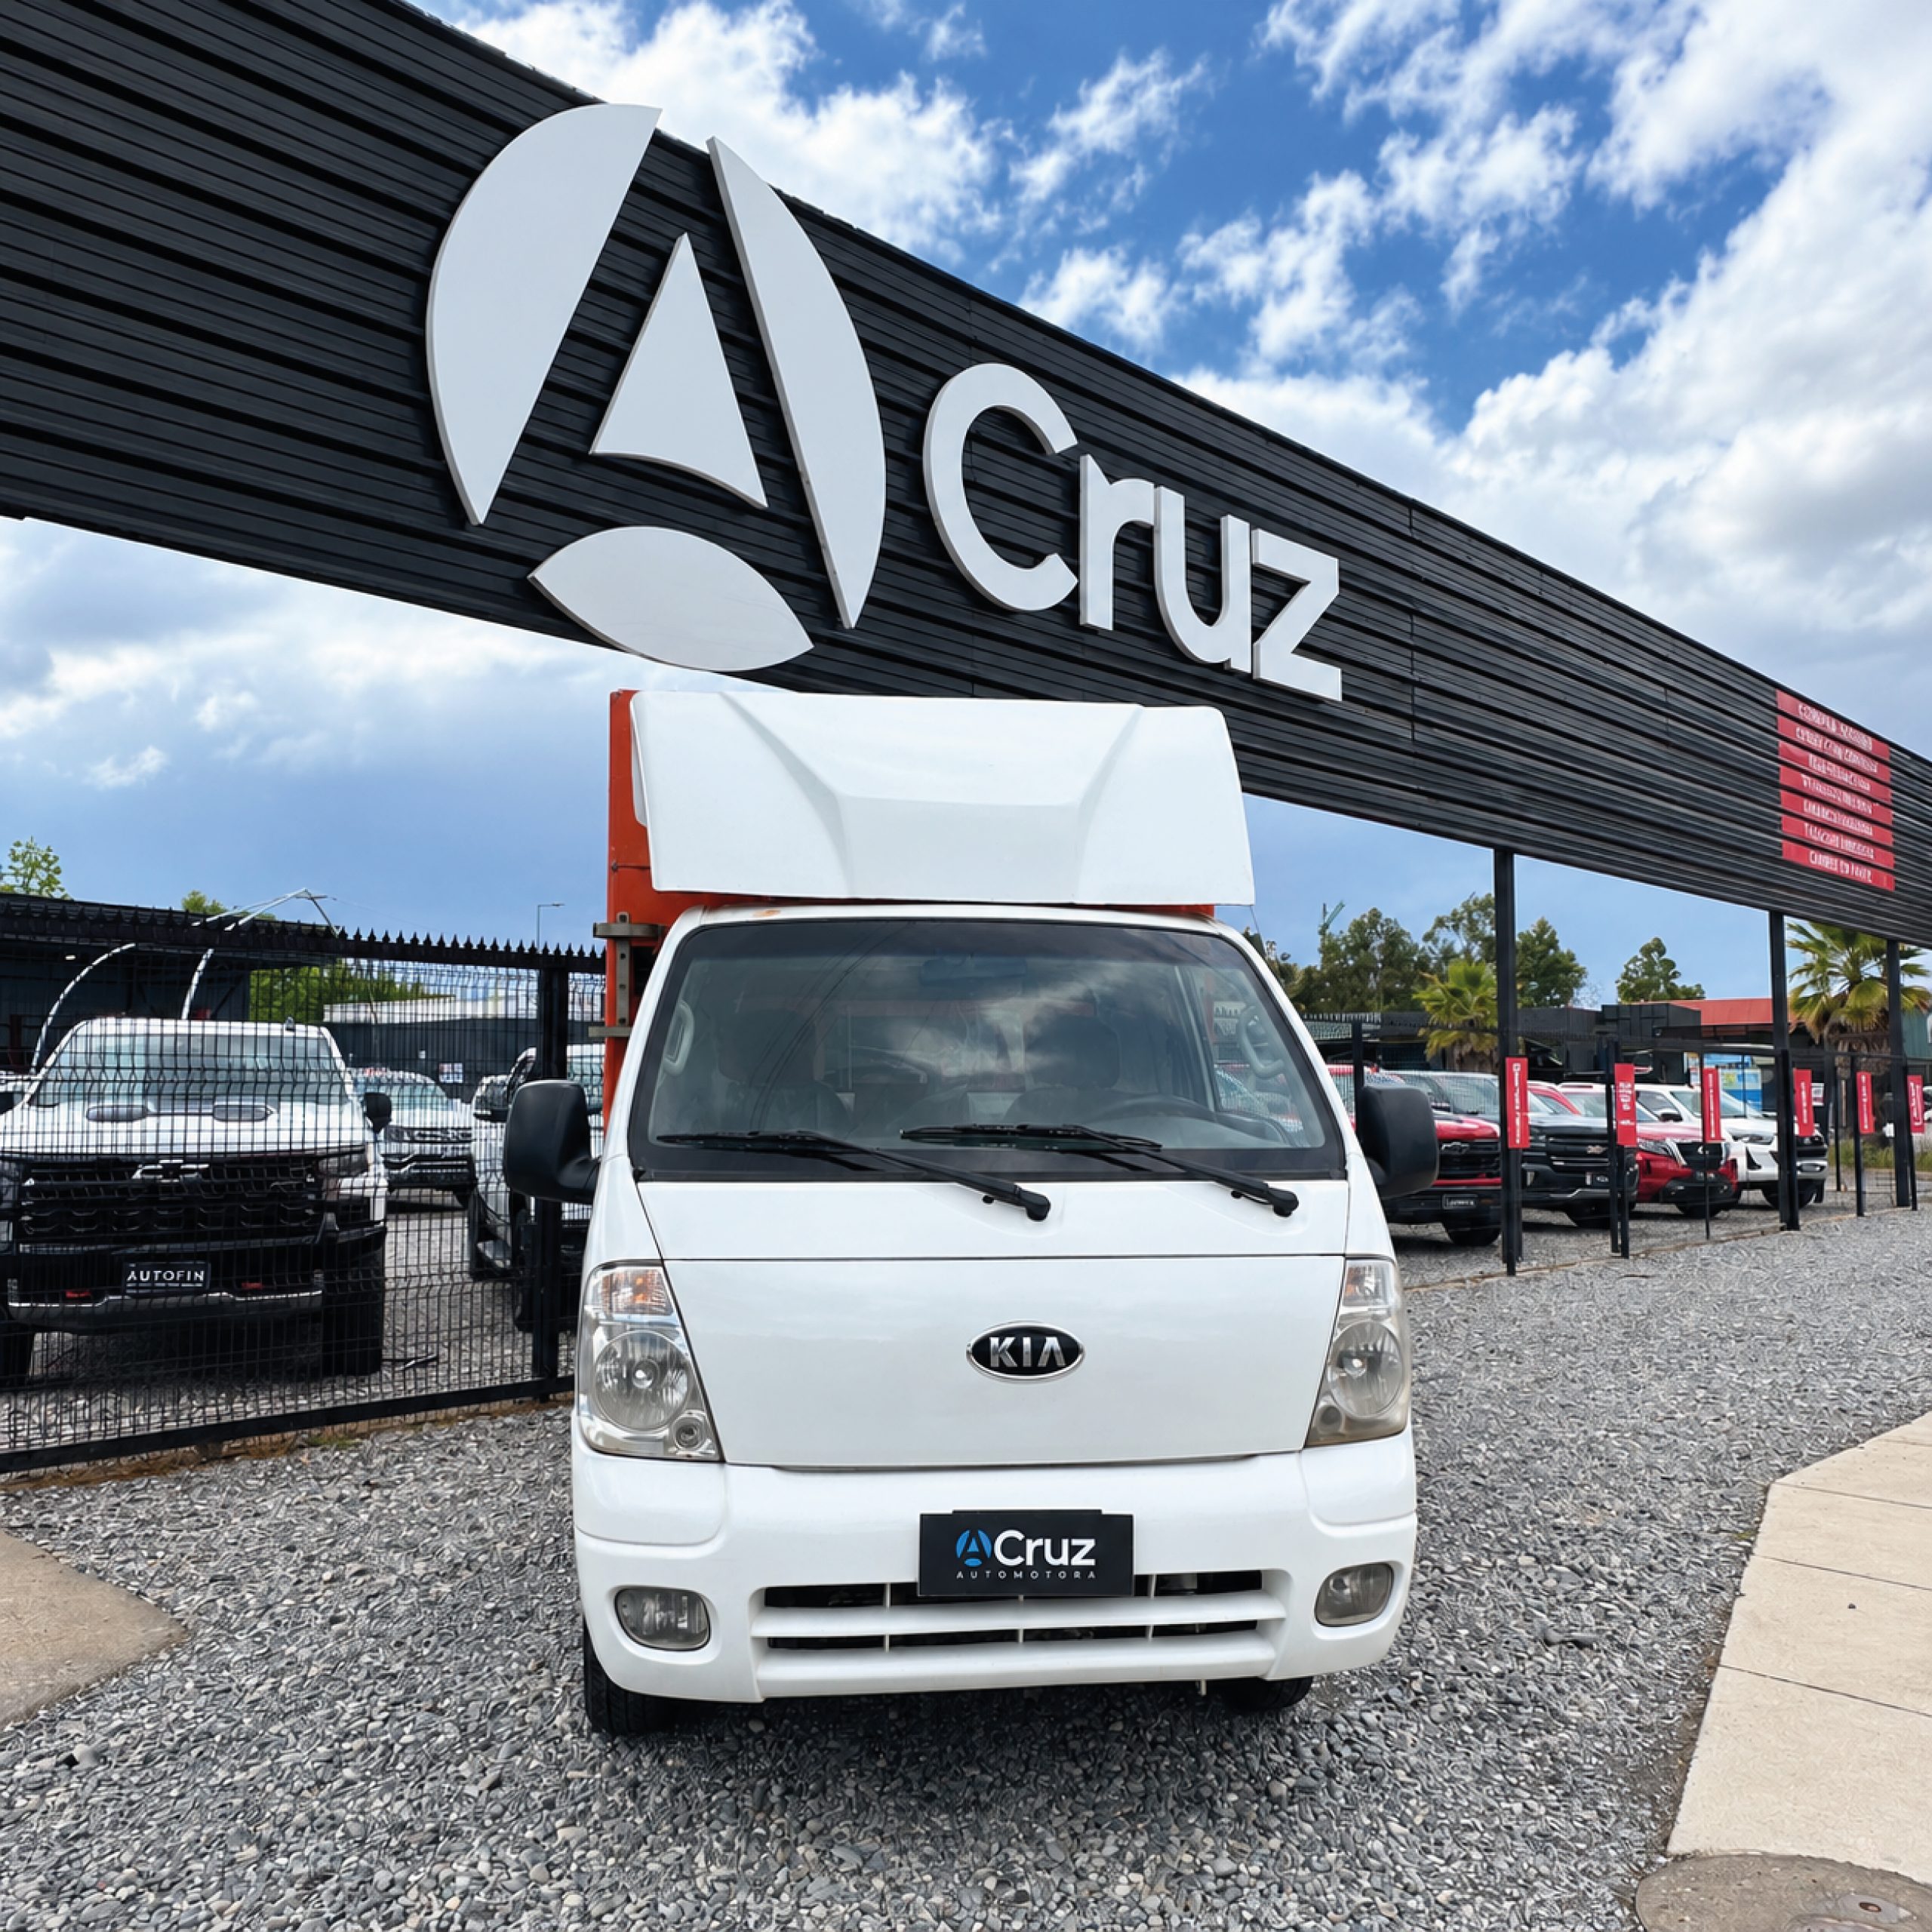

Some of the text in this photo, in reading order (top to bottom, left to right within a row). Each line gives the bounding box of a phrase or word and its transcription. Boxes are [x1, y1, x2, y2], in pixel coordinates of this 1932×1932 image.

[127, 1270, 205, 1281] AUTOFIN
[989, 1337, 1066, 1367] KIA
[955, 1570, 1097, 1580] AUTOMOTORA
